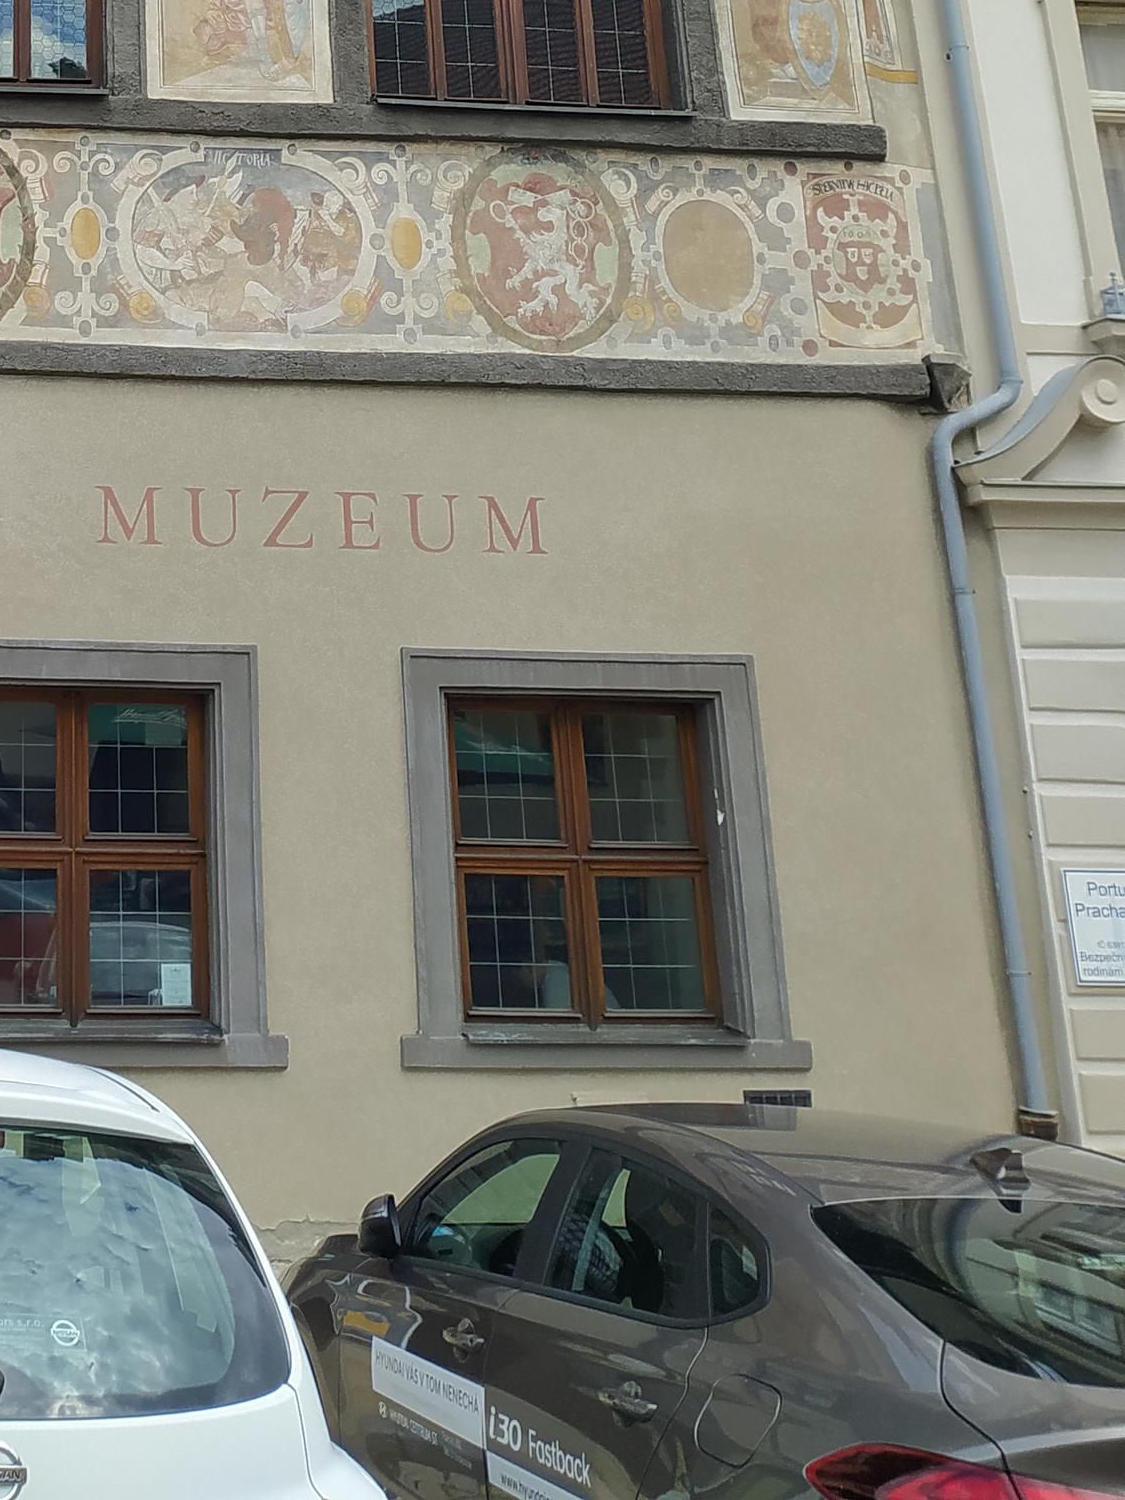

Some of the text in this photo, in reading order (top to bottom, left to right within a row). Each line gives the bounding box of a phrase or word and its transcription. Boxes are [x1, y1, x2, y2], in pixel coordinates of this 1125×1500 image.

[94, 484, 549, 555] MUZEUM
[375, 1349, 405, 1377] HYUNDAI
[426, 1373, 442, 1396] TOM
[489, 1405, 522, 1452] i30
[528, 1428, 591, 1488] Fastback
